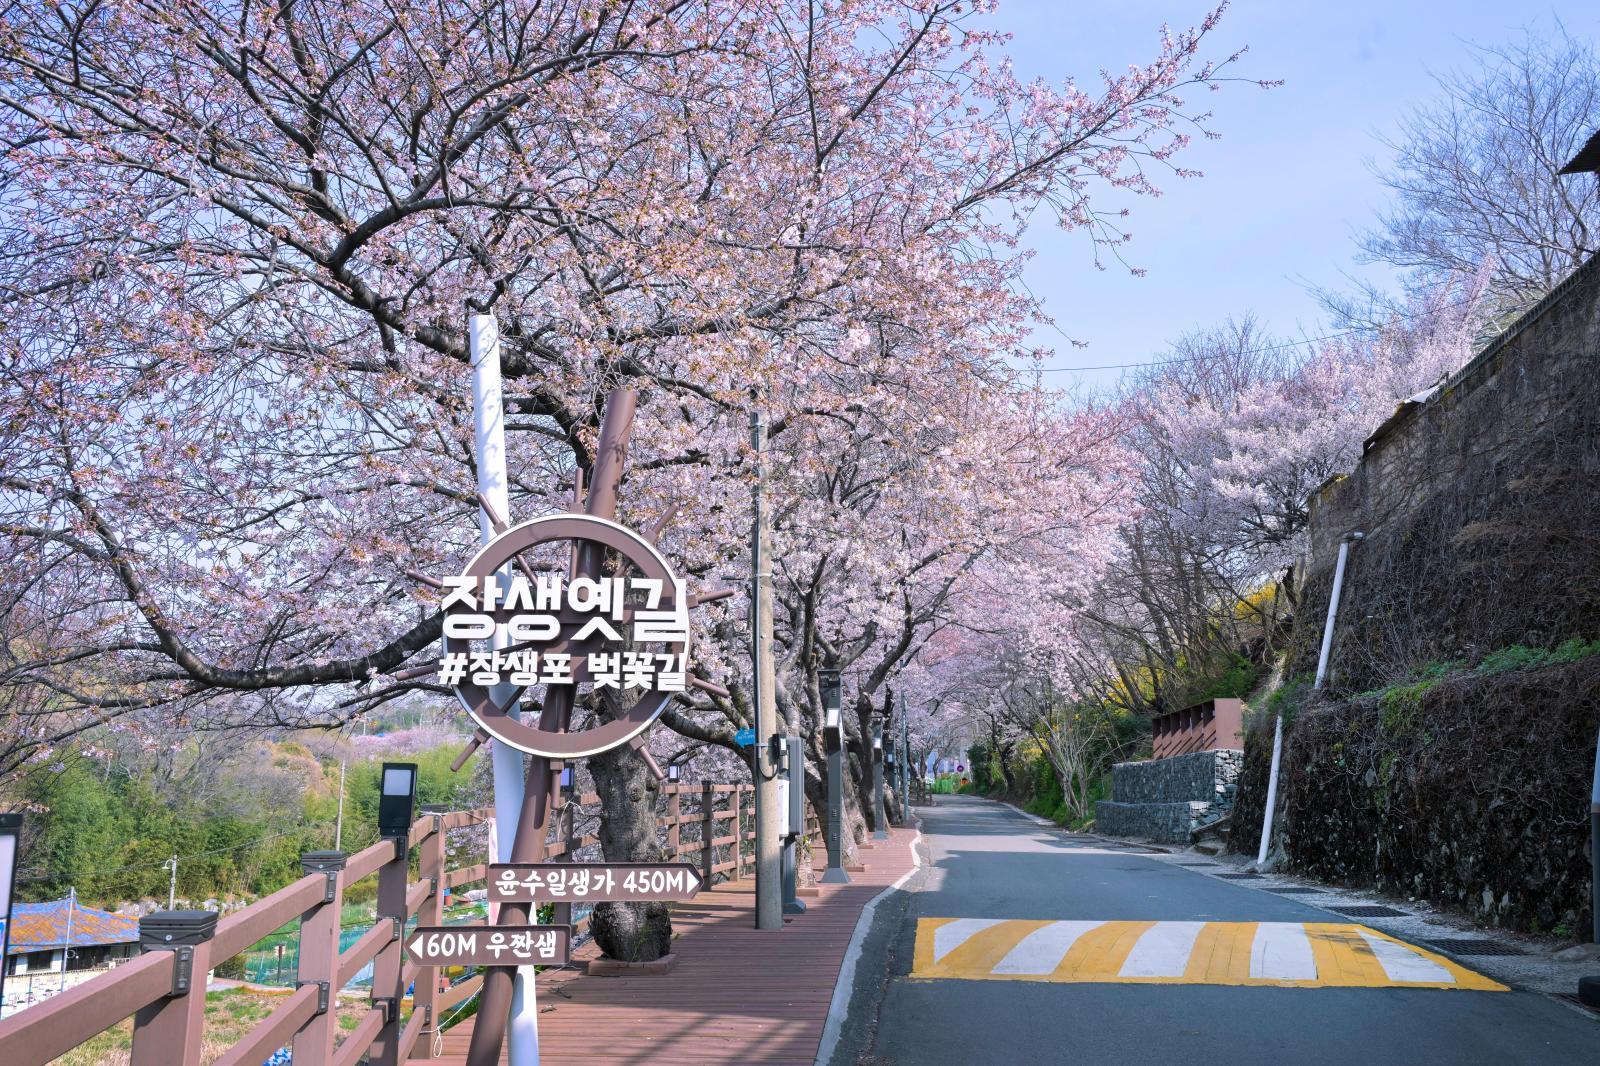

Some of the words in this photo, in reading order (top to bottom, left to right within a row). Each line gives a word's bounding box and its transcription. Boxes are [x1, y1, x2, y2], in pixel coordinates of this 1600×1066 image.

[441, 575, 687, 642] 장생옛길
[437, 650, 574, 686] #장생포
[588, 651, 686, 692] 벚꽃길
[495, 869, 615, 896] 윤수일생가
[623, 870, 683, 894] 450M
[426, 933, 477, 957] 60M
